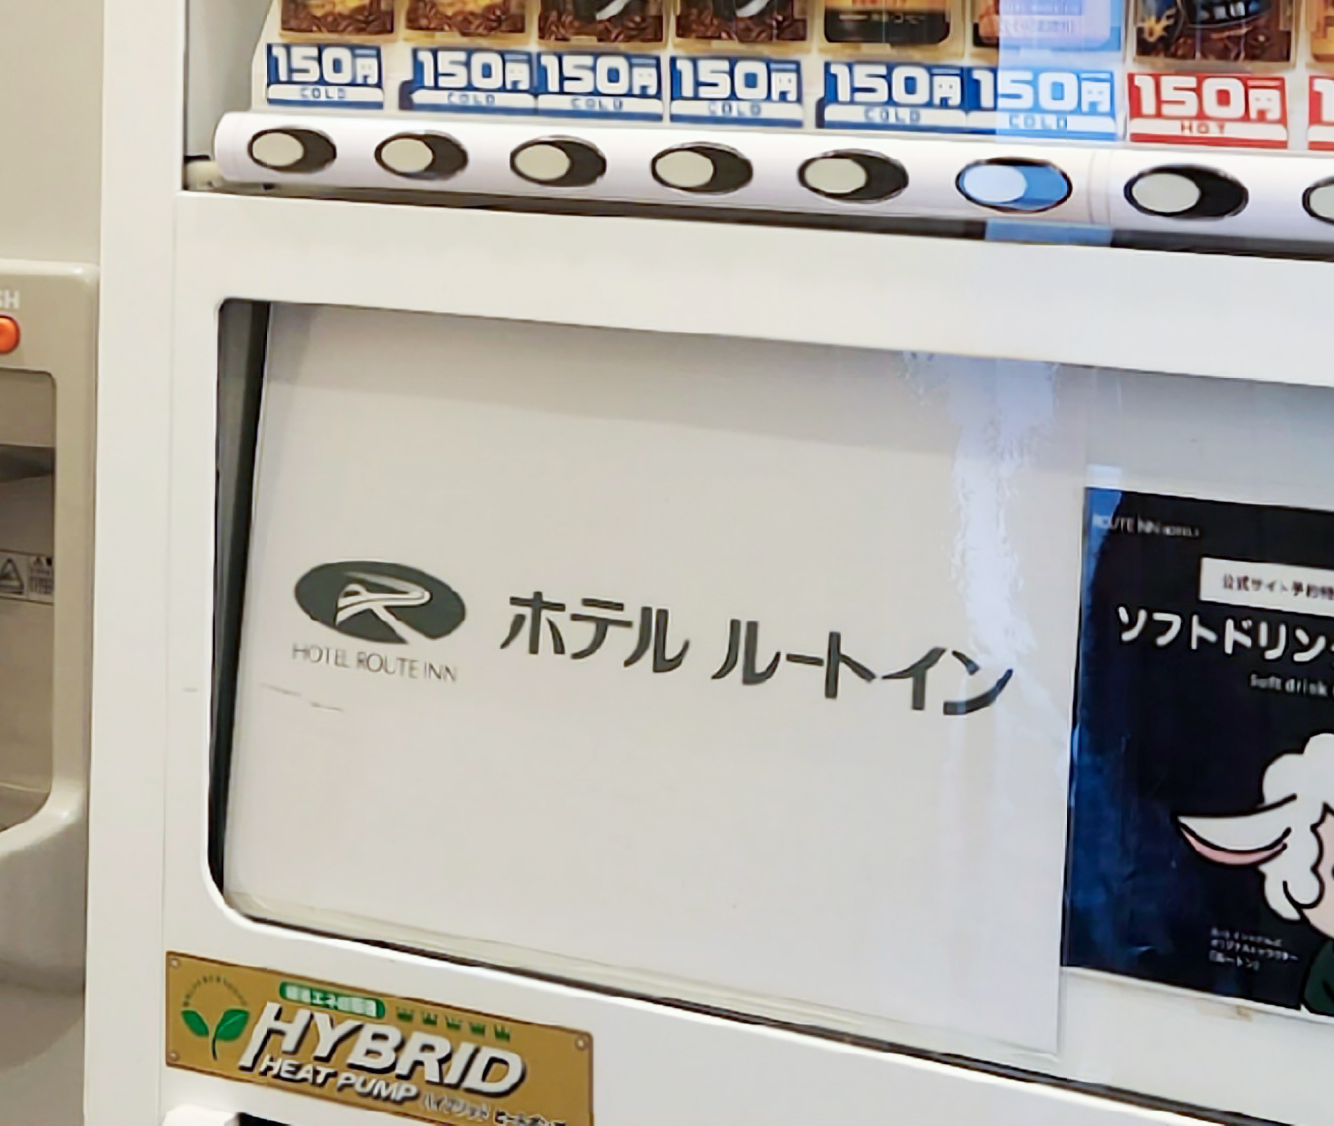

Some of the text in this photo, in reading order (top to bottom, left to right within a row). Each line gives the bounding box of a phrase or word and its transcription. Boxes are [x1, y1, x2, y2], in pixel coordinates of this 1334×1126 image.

[270, 46, 379, 85] 150円
[417, 50, 532, 90] 150円
[540, 55, 659, 97] 150円
[676, 59, 798, 102] 150円
[829, 63, 962, 107] 150円
[970, 70, 1113, 113] 150円
[1132, 75, 1282, 120] 150円
[863, 107, 921, 124] COLD
[1008, 113, 1068, 130] COLD
[1180, 120, 1227, 135] HOT
[291, 643, 458, 682] HOTEL ROUTE INN
[499, 589, 1014, 716] ホテル ルートイン
[1250, 672, 1283, 693] Soft
[1284, 674, 1328, 698] drink
[238, 1000, 527, 1098] HYBRID
[260, 1057, 420, 1105] HEAT PUMP
